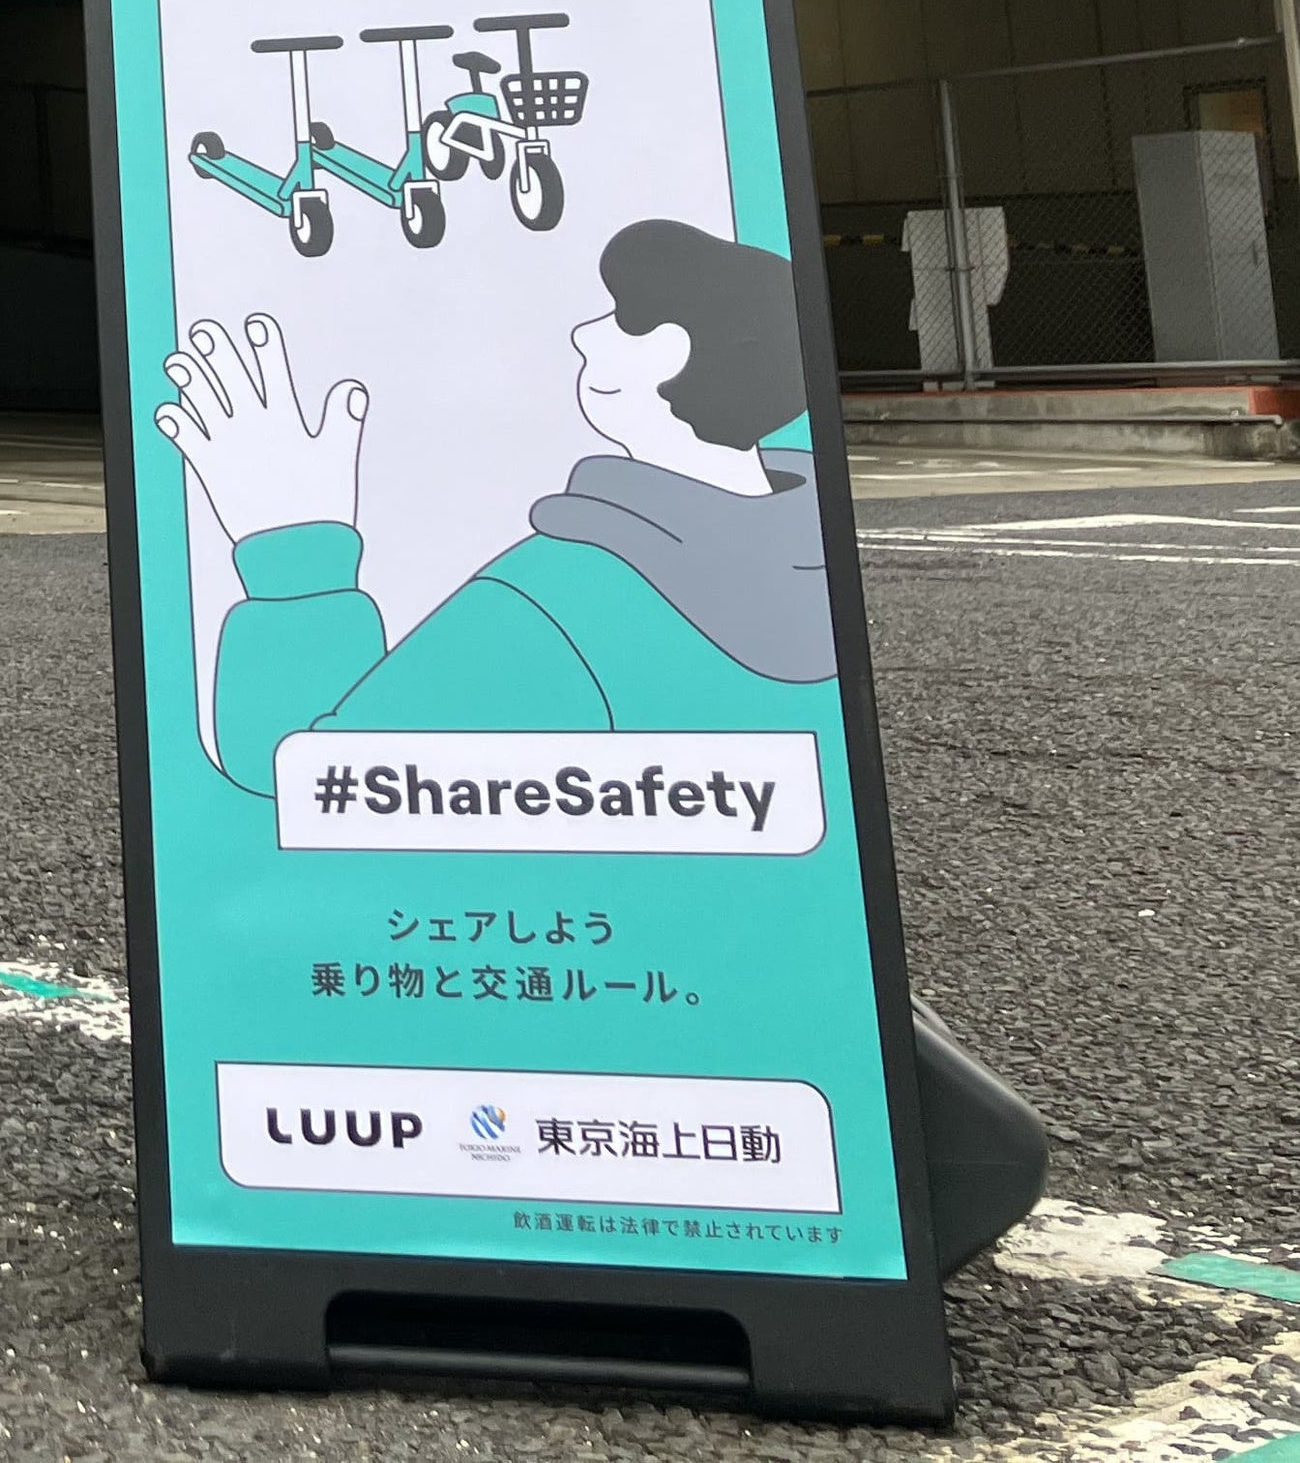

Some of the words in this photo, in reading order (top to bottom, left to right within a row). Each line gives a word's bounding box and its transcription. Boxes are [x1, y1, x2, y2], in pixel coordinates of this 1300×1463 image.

[314, 763, 776, 832] #ShareSafety
[387, 908, 613, 946] シェアしよう
[310, 961, 702, 1008] 乗り物と交通ルール。
[265, 1107, 424, 1150] LUUP
[535, 1117, 782, 1165] 東京海上日動
[513, 1211, 843, 1244] 飲酒運転は法律で禁止されています
